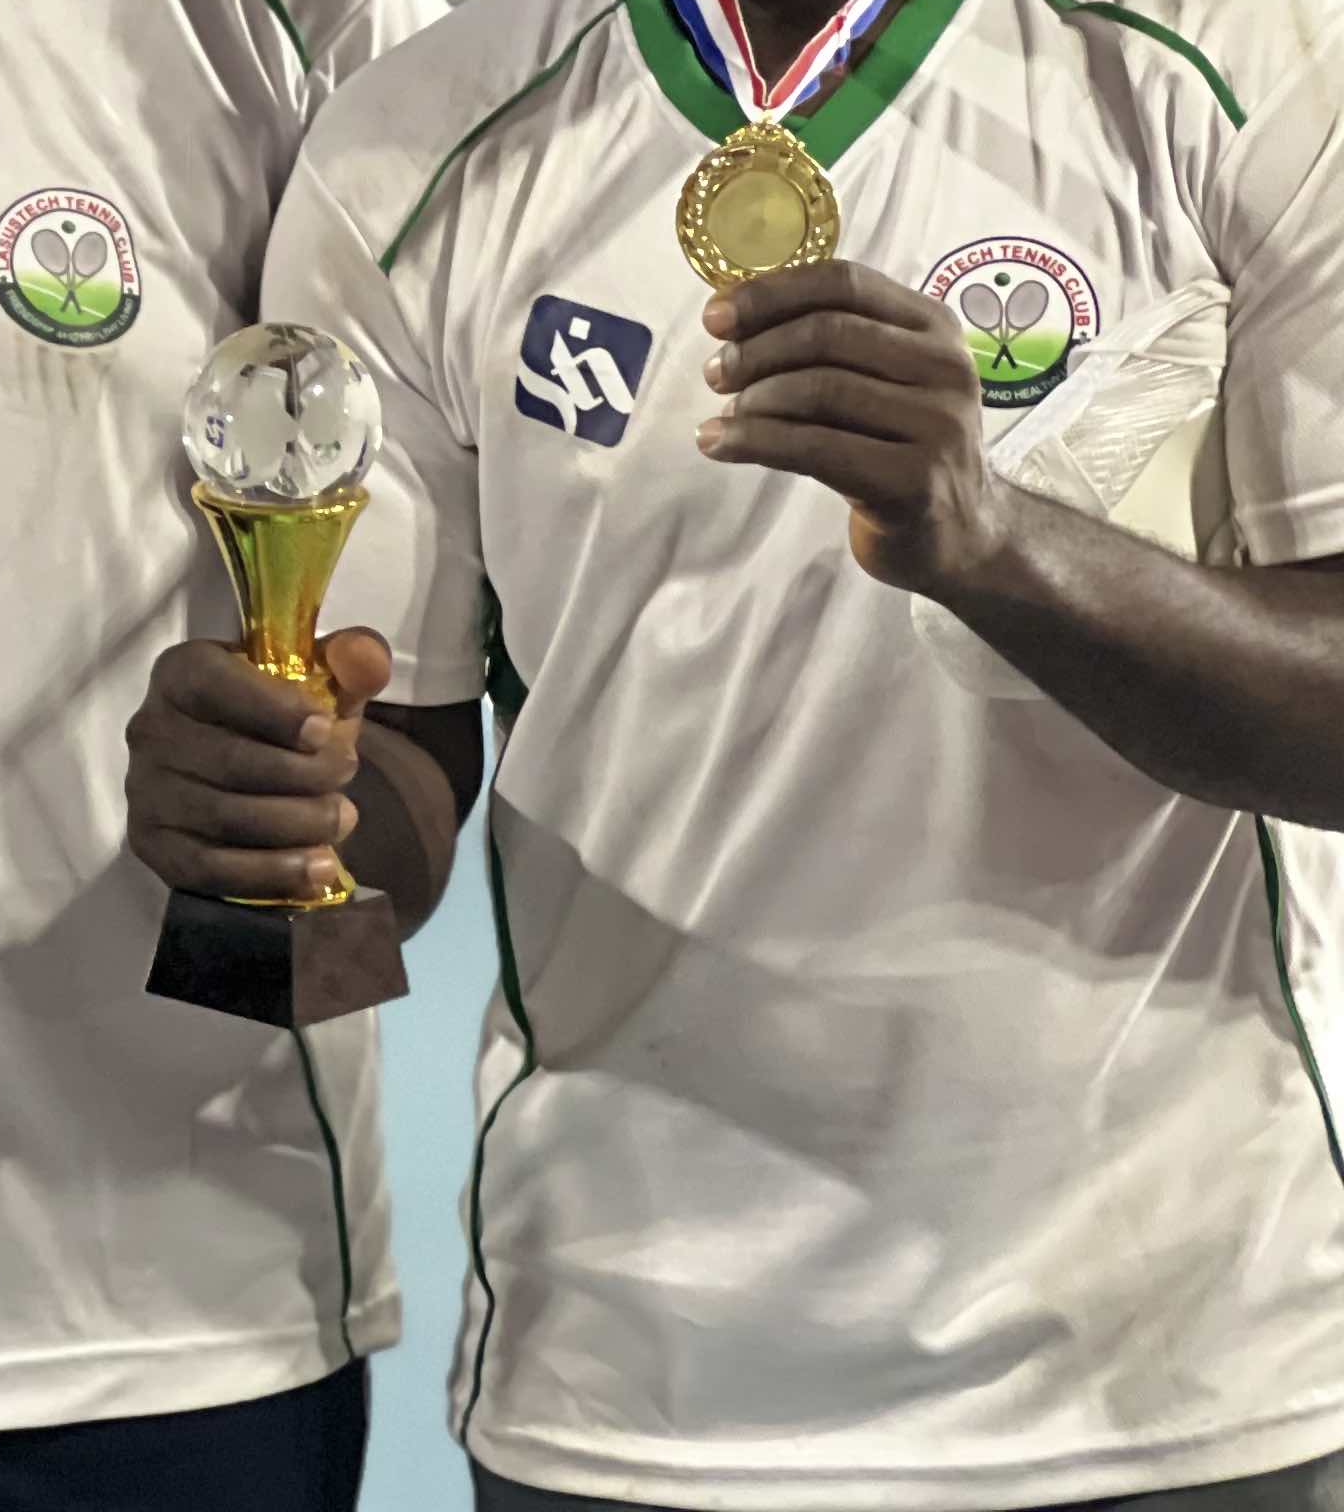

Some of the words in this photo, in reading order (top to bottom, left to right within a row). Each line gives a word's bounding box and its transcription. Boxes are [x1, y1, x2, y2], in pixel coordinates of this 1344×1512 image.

[64, 196, 122, 233] TENNIS
[116, 236, 135, 283] CLUB
[929, 246, 993, 298] USTECH
[1000, 245, 1067, 277] TENNIS
[1065, 277, 1091, 327] CLUB
